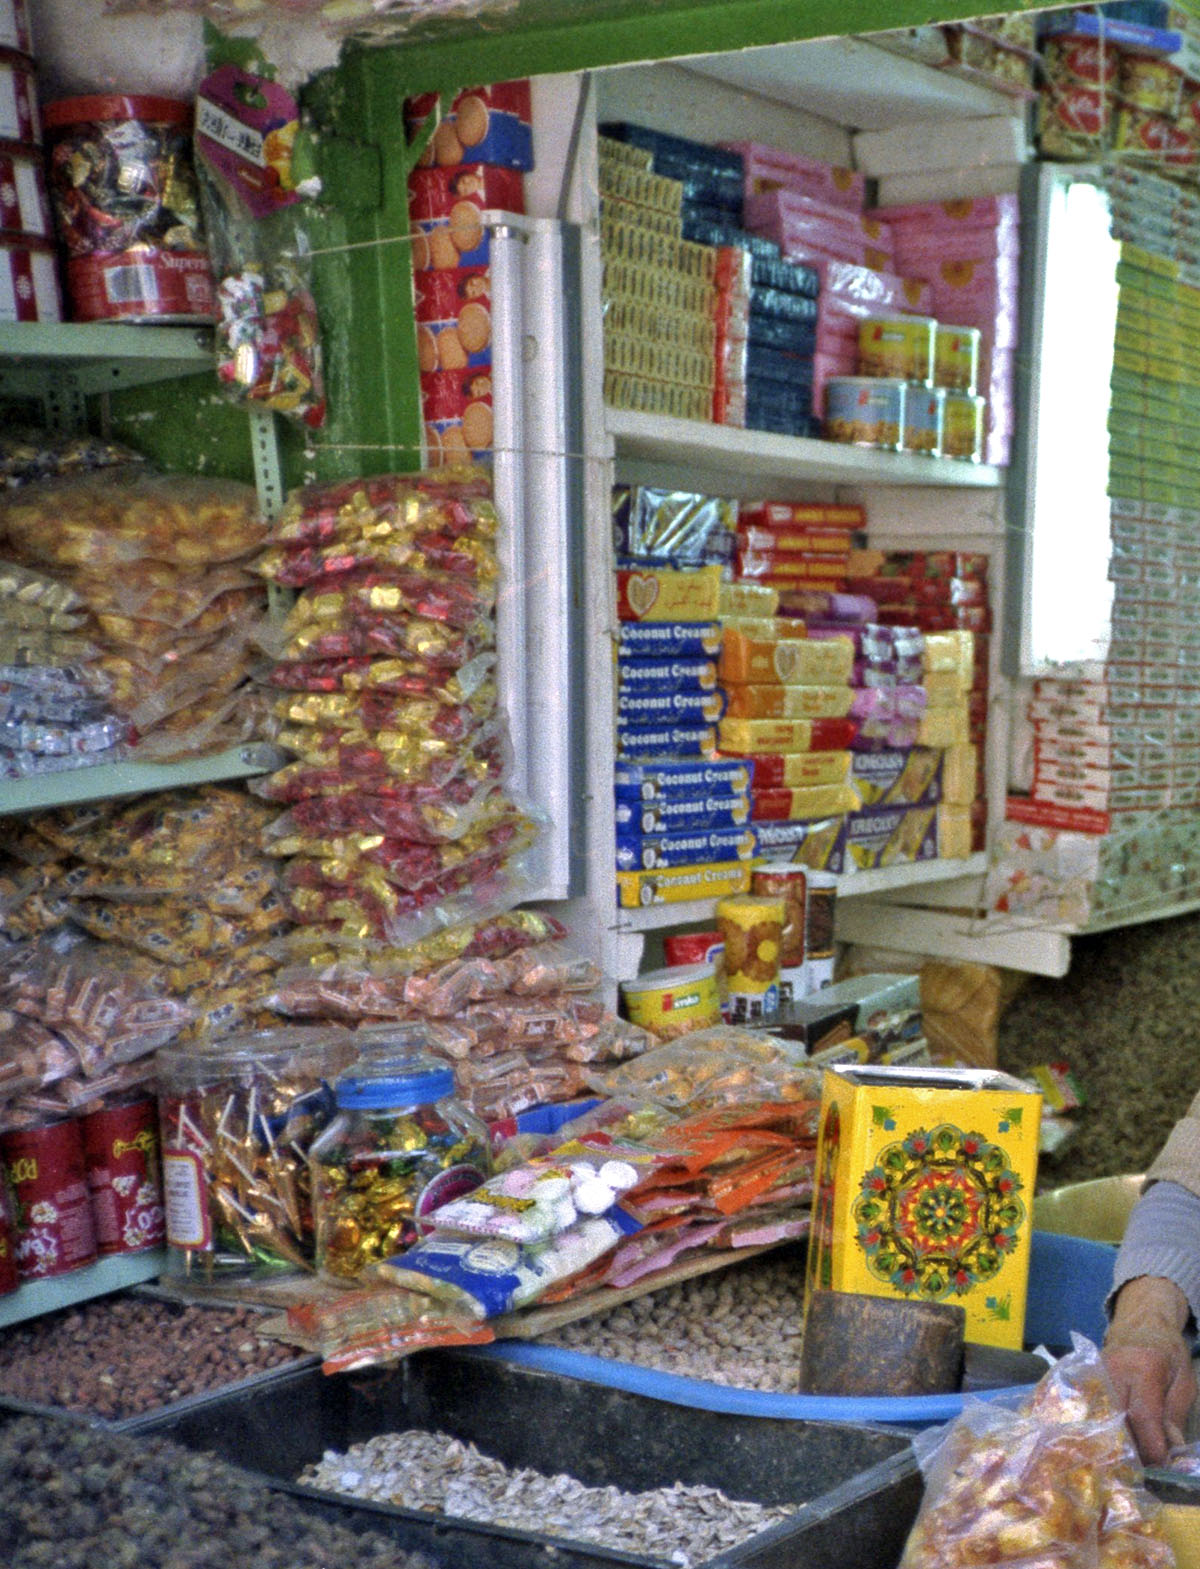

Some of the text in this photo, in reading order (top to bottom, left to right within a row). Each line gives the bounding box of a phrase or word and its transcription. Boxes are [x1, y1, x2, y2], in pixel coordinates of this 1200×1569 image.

[621, 626, 671, 640] Coconut
[622, 665, 669, 679] Coconut
[620, 696, 671, 710] Coconut
[621, 732, 670, 746] Coconut
[657, 772, 703, 786] Coconut
[658, 801, 704, 815] Coconut
[660, 838, 708, 851] Coconut
[657, 875, 702, 888] Coconut
